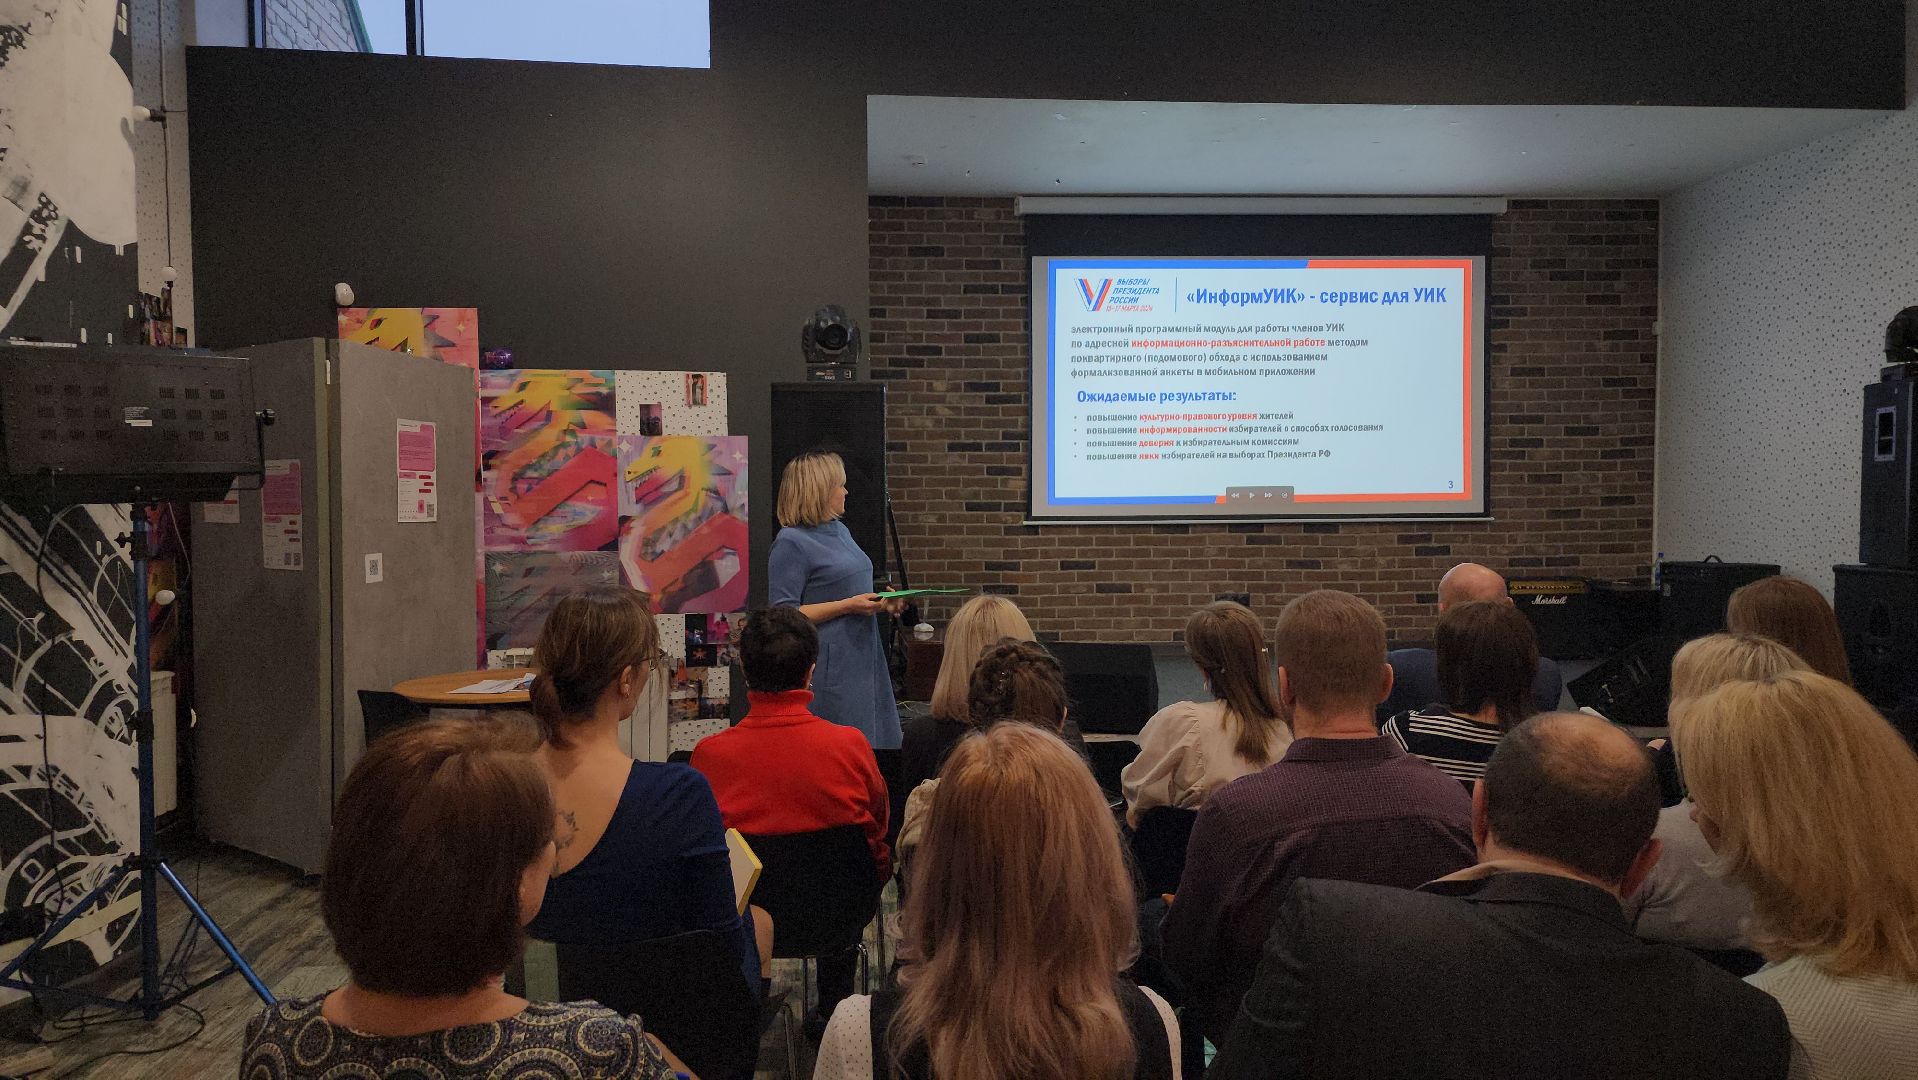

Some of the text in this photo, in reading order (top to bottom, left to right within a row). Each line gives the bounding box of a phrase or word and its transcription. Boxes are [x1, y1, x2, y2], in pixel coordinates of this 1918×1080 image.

[1117, 278, 1151, 286] ВЫБОРЫ
[1112, 288, 1160, 296] ПРЕЗИДЕНТА
[1187, 288, 1305, 306] «ИнформУИК»
[1320, 291, 1378, 306] сервис
[1381, 292, 1409, 305] для
[1414, 288, 1447, 303] УИК
[1109, 296, 1140, 304] РОССИИ
[1071, 324, 1134, 333] электронный
[1135, 323, 1202, 336] программный
[1203, 326, 1236, 336] модуль
[1236, 326, 1253, 334] для
[1255, 324, 1290, 336] работы
[1326, 324, 1345, 332] УИК
[1071, 338, 1368, 352] по адресной информационно-разъяснительной работе методом
[1071, 352, 1328, 366] поквартирного (подомового) обхода с использованием
[1071, 366, 1158, 378] формализованной
[1160, 368, 1194, 376] анкеты
[1204, 366, 1256, 376] мобильном
[1259, 368, 1316, 378] приложении
[1077, 390, 1237, 404] Ожидаемые результаты:
[1140, 413, 1227, 422] культурно-правового
[1228, 412, 1258, 422] уровня
[1259, 411, 1294, 420] жителей
[1140, 426, 1227, 435] информированности
[1228, 424, 1282, 434] избирателей
[1290, 424, 1329, 434] способах
[1330, 424, 1384, 432] голосования
[1139, 440, 1174, 448] доверия
[1182, 438, 1250, 448] избирательным
[1251, 438, 1299, 446] комиссиям
[1162, 450, 1215, 460] избирателей
[1228, 450, 1266, 460] выборах
[1267, 450, 1317, 460] Президента
[1318, 450, 1331, 458] РФ
[1448, 480, 1454, 489] 3
[1532, 594, 1568, 604] Marshall
